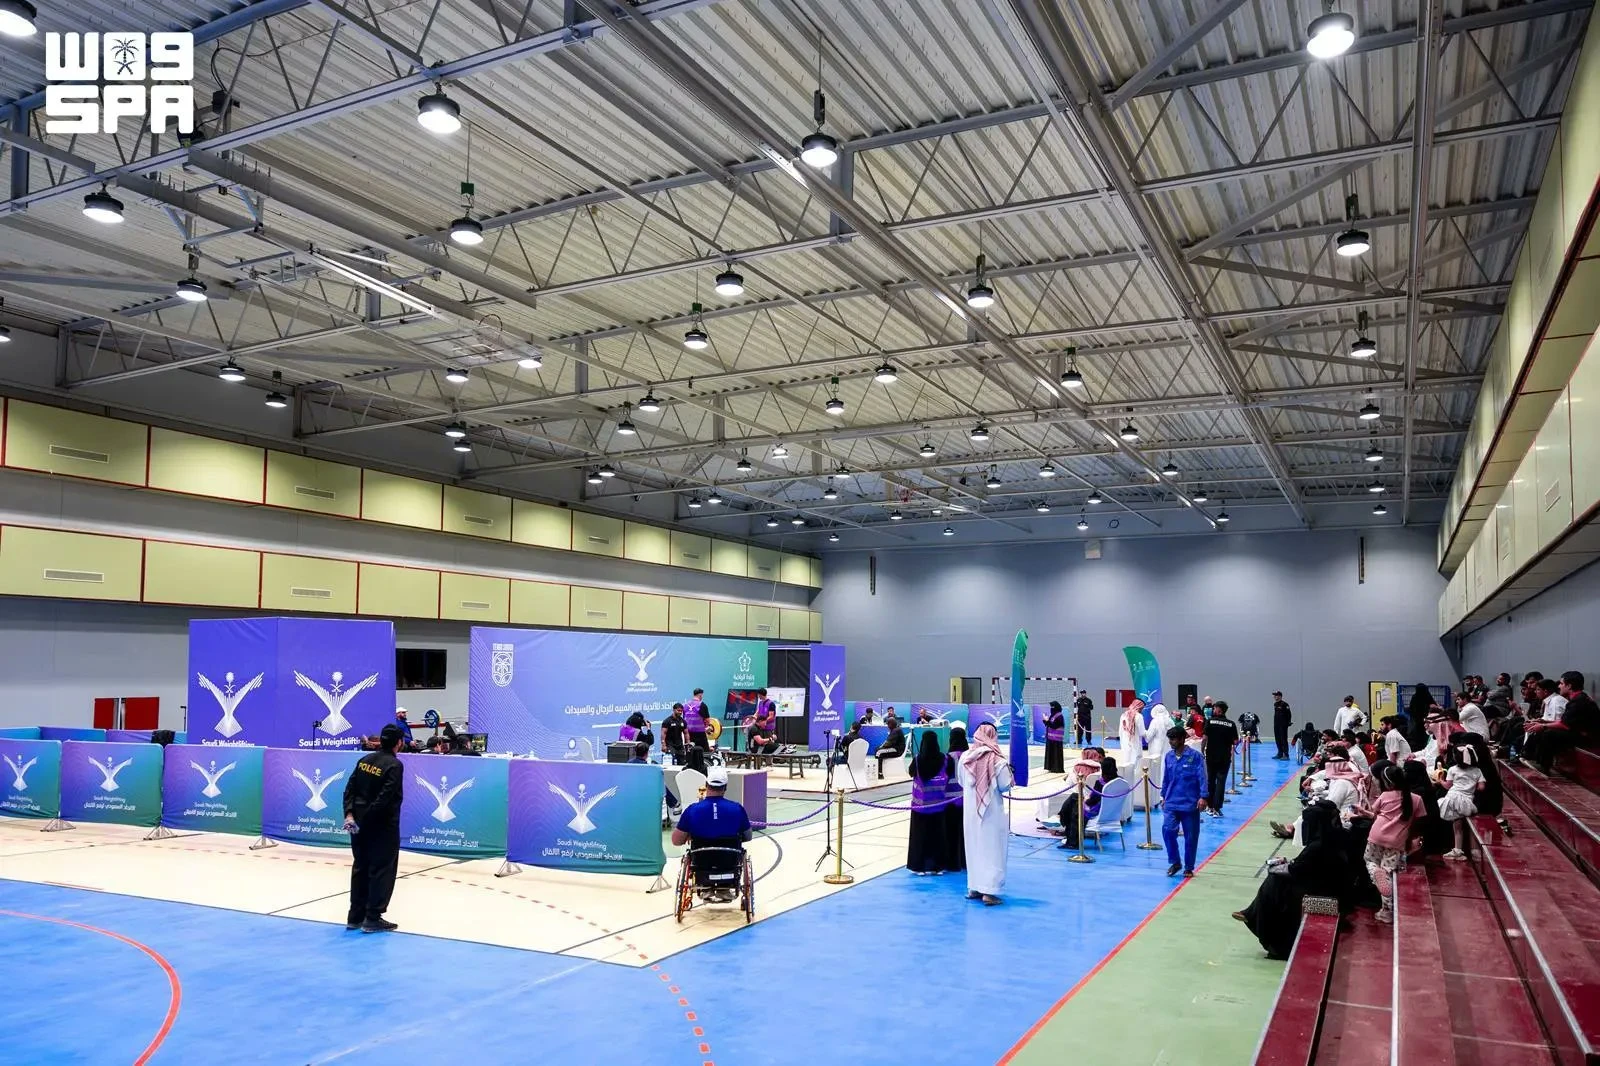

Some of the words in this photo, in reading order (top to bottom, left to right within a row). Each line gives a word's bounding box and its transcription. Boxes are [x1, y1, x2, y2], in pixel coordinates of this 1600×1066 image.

[299, 738, 321, 748] Saudi
[358, 762, 383, 777] POLICE
[422, 827, 435, 835] Saudi
[435, 828, 465, 839] Weightlifting
[557, 838, 573, 847] Saudi
[573, 839, 607, 852] Weightlifting
